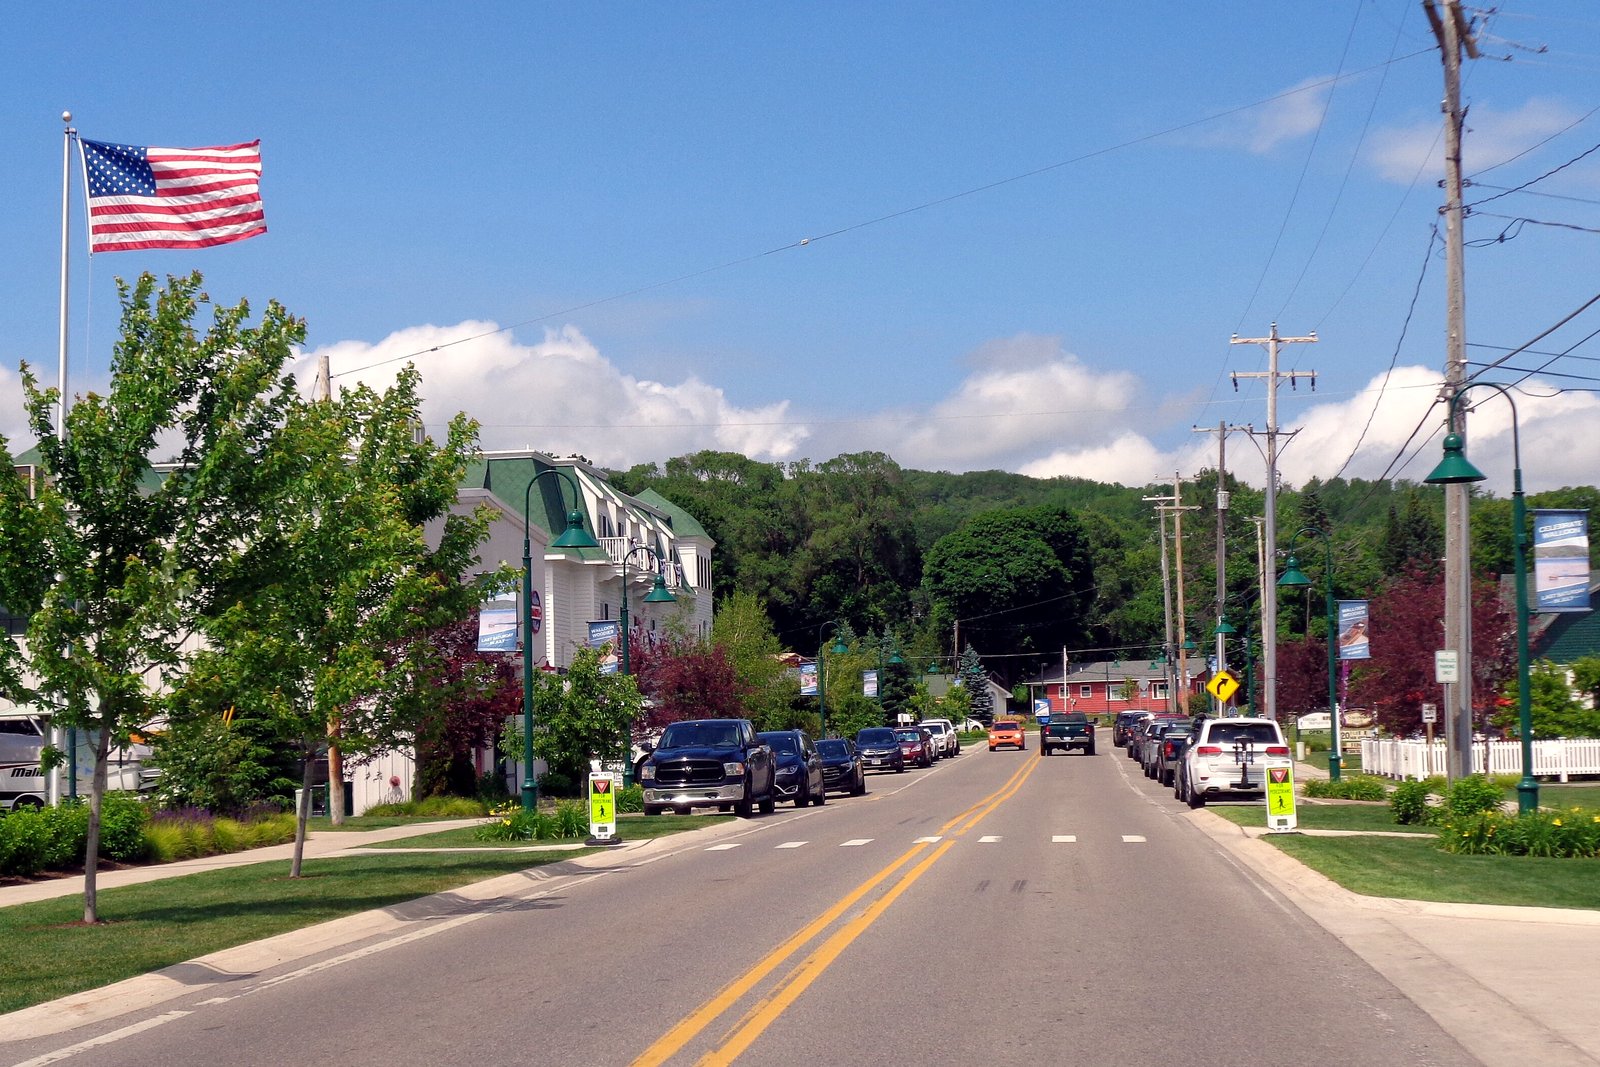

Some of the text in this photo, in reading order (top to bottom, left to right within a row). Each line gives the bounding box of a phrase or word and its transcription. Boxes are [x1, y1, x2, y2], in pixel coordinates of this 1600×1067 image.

[1539, 520, 1583, 532] CELEBRATE
[1542, 527, 1580, 538] WALLOON
[591, 625, 615, 633] WALLOON
[592, 630, 614, 638] WOODIES
[10, 767, 44, 777] Mali
[607, 763, 625, 772] OPEN
